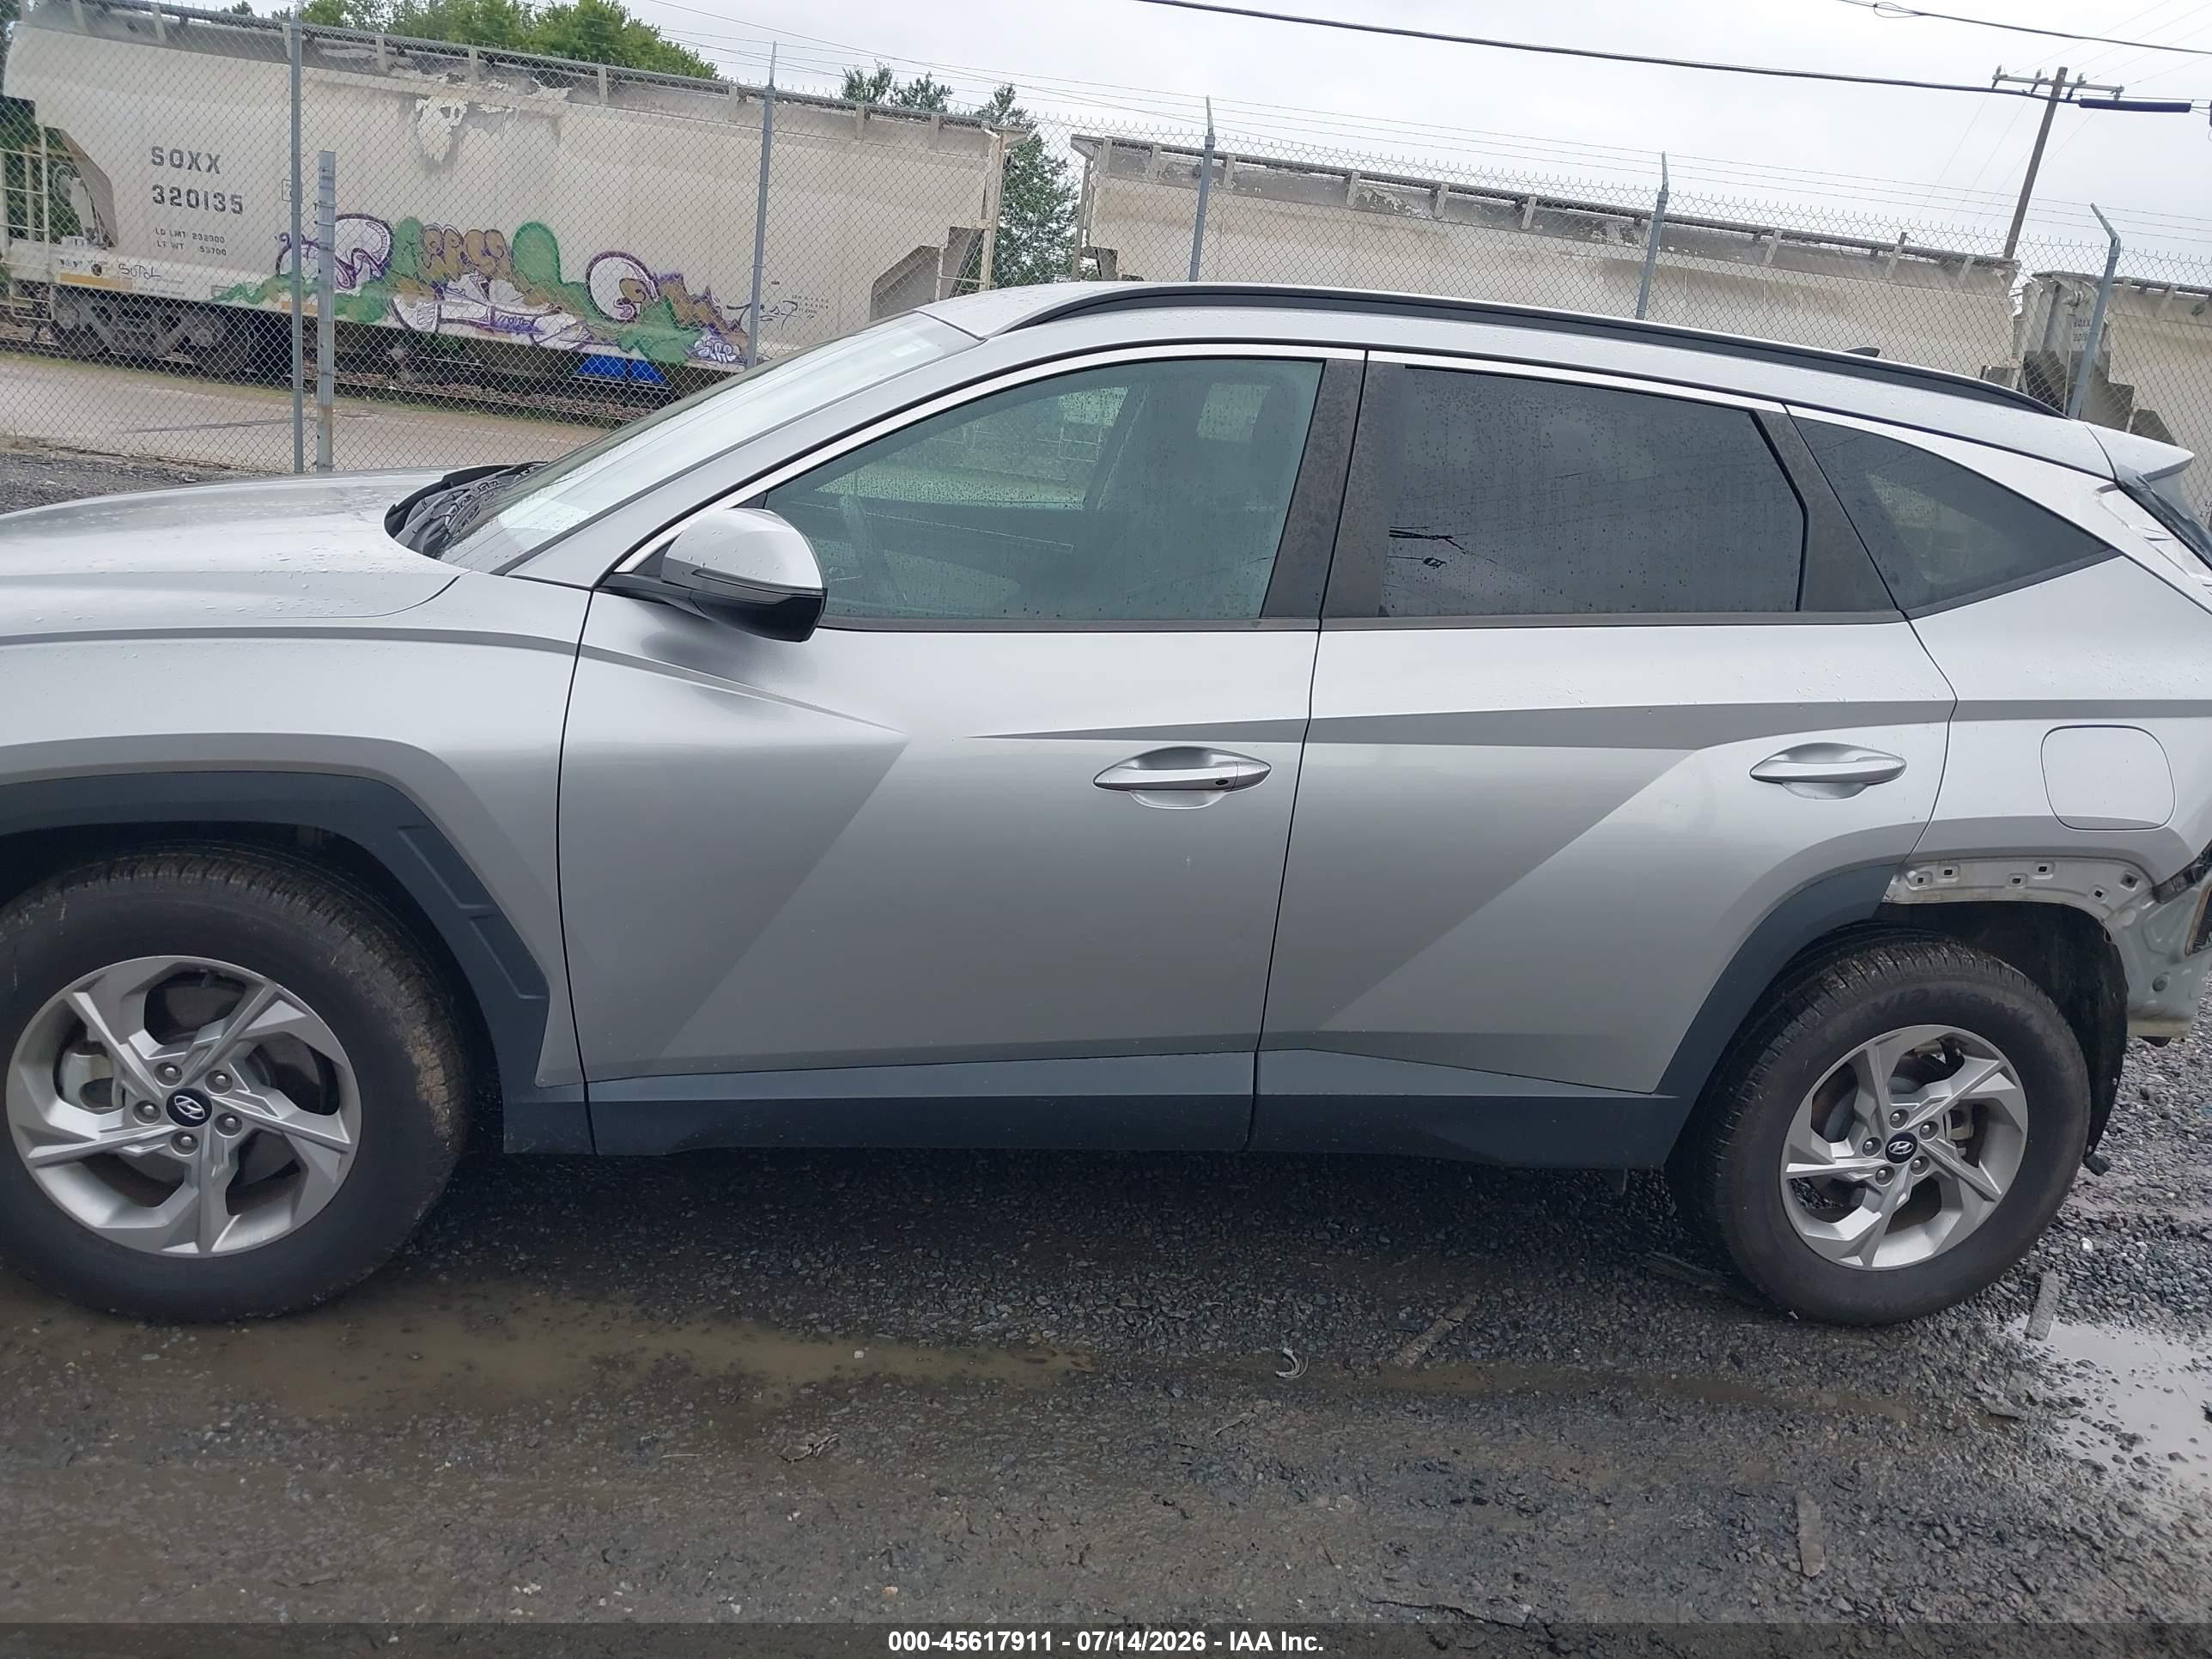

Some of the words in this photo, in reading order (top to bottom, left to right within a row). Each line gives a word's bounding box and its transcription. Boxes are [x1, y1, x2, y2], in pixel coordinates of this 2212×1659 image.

[151, 146, 221, 174] SOXX
[152, 185, 243, 215] 320135
[155, 227, 166, 235] LD
